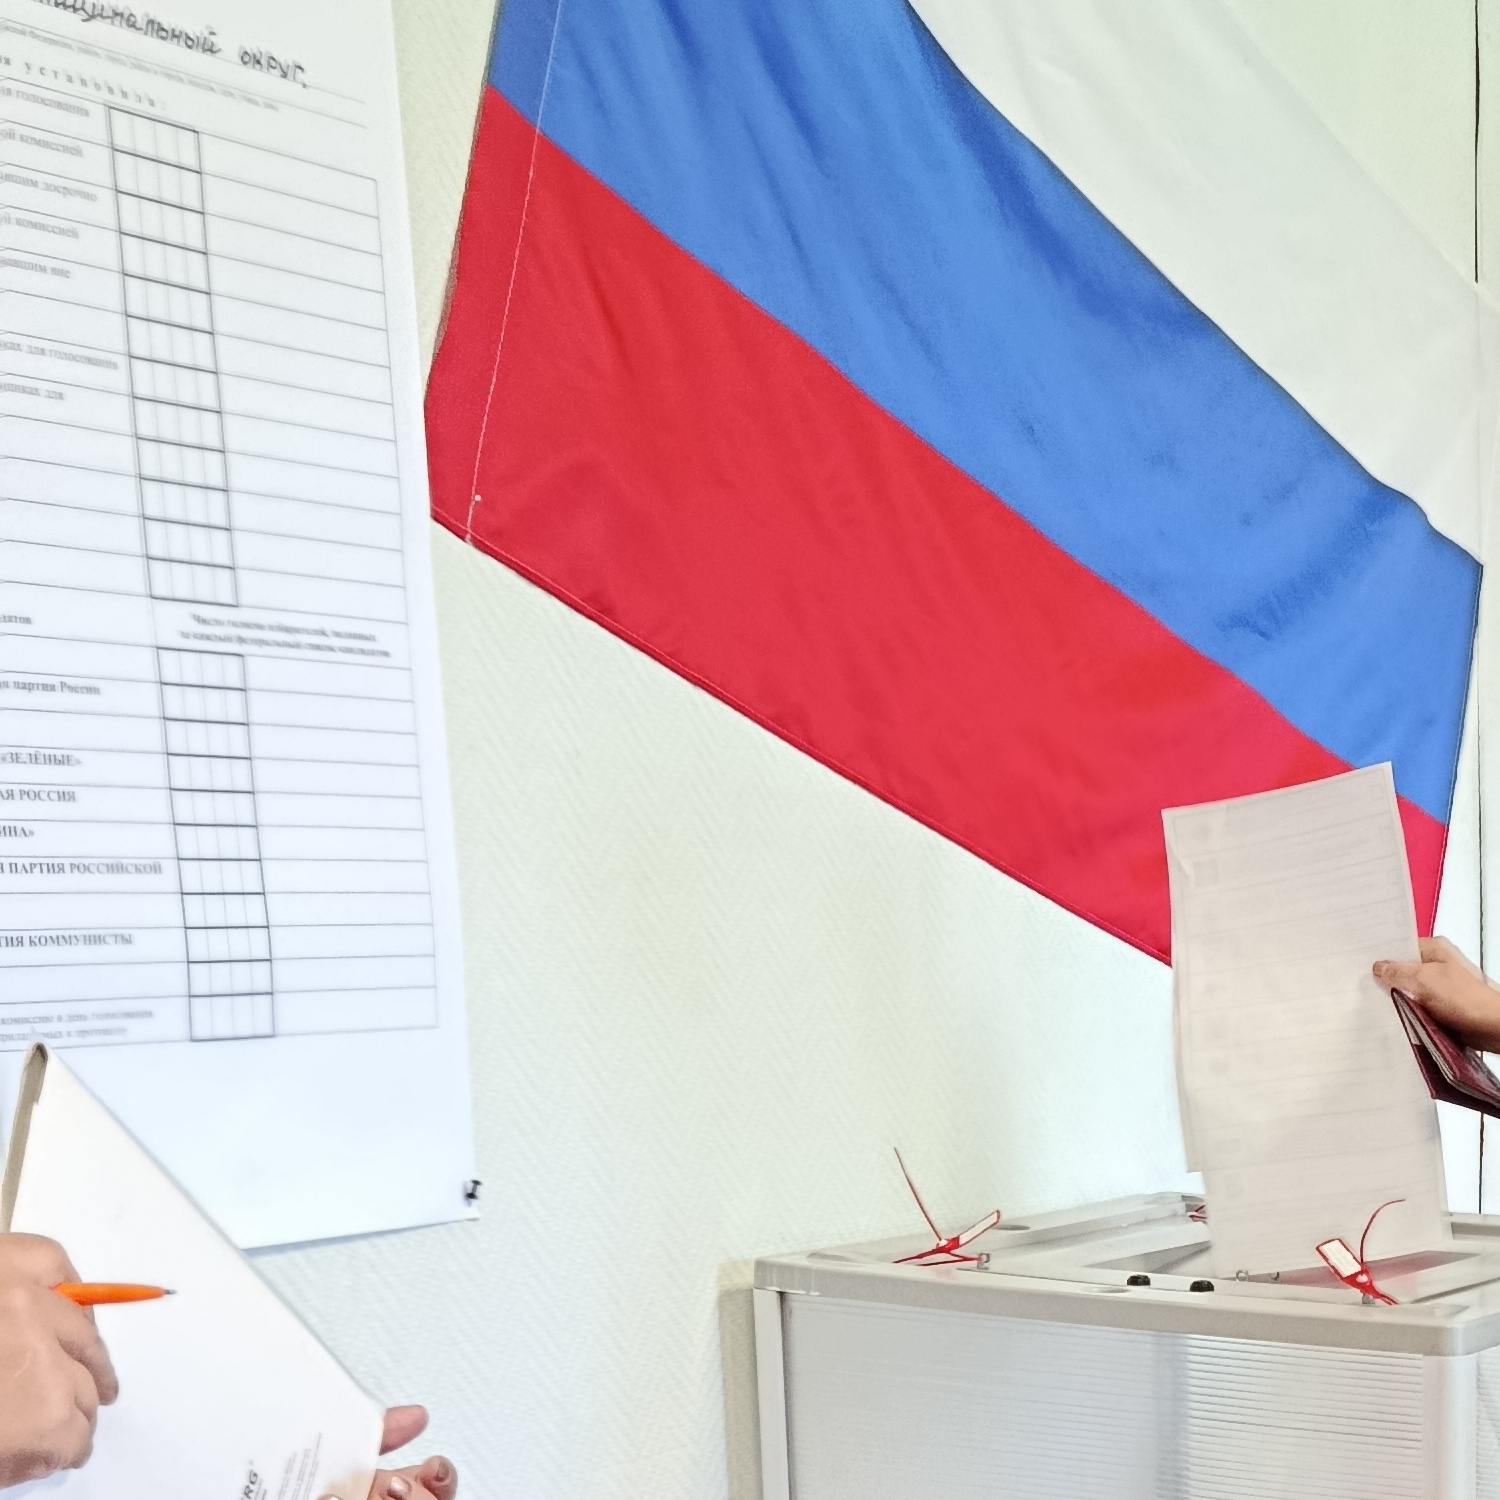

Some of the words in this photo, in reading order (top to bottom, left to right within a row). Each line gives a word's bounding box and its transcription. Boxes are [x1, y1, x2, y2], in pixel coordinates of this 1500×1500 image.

[19, 789, 77, 802] РОССИЯ
[9, 862, 67, 875] ПАРТИЯ
[69, 861, 164, 875] РОССИЙСКОЙ
[28, 933, 134, 948] КОММУНИСТЫ
